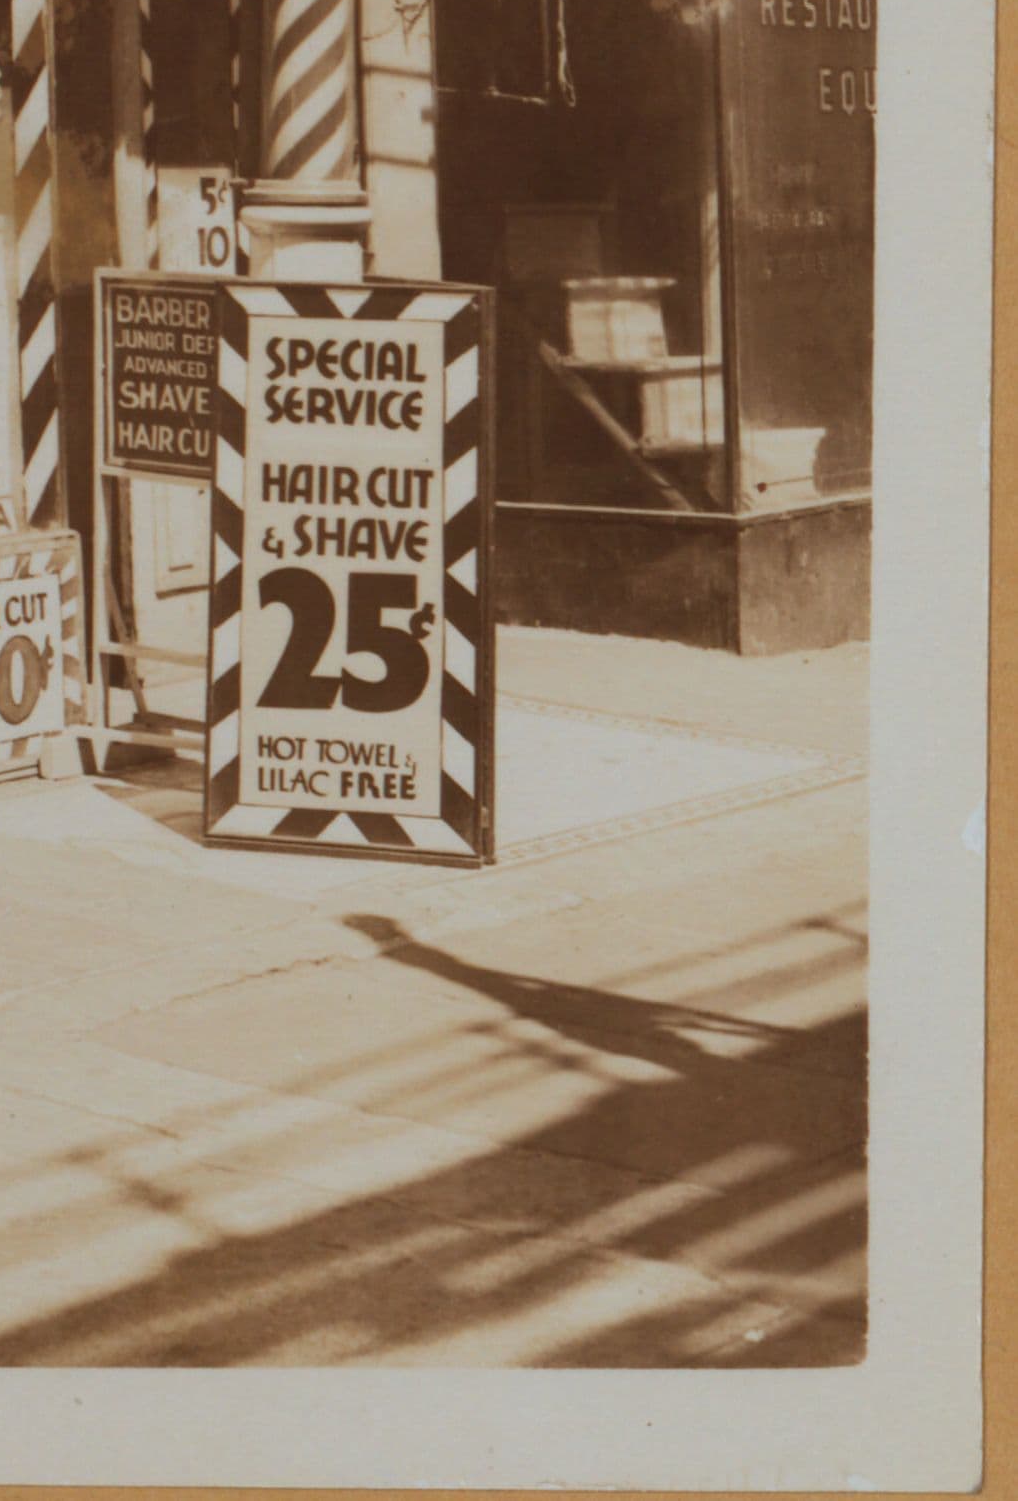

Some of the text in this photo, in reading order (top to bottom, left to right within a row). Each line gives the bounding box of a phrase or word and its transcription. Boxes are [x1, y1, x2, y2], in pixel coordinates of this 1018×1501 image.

[197, 225, 231, 269] 10
[115, 295, 210, 329] BARBER
[115, 329, 175, 351] JUNIOR
[123, 355, 208, 380] ADVANCED
[265, 336, 427, 383] SPECIAL
[118, 381, 212, 416] SHAVE
[264, 384, 424, 432] SERVICE
[118, 421, 175, 453] HAIR
[262, 462, 435, 510] HAIR CUT
[261, 514, 430, 564] & SHAVE
[4, 592, 49, 628] CUT
[255, 566, 437, 714] 25¢
[258, 735, 307, 762] HOT
[315, 739, 400, 770] TOWEL
[257, 766, 418, 801] LILAC FREE
